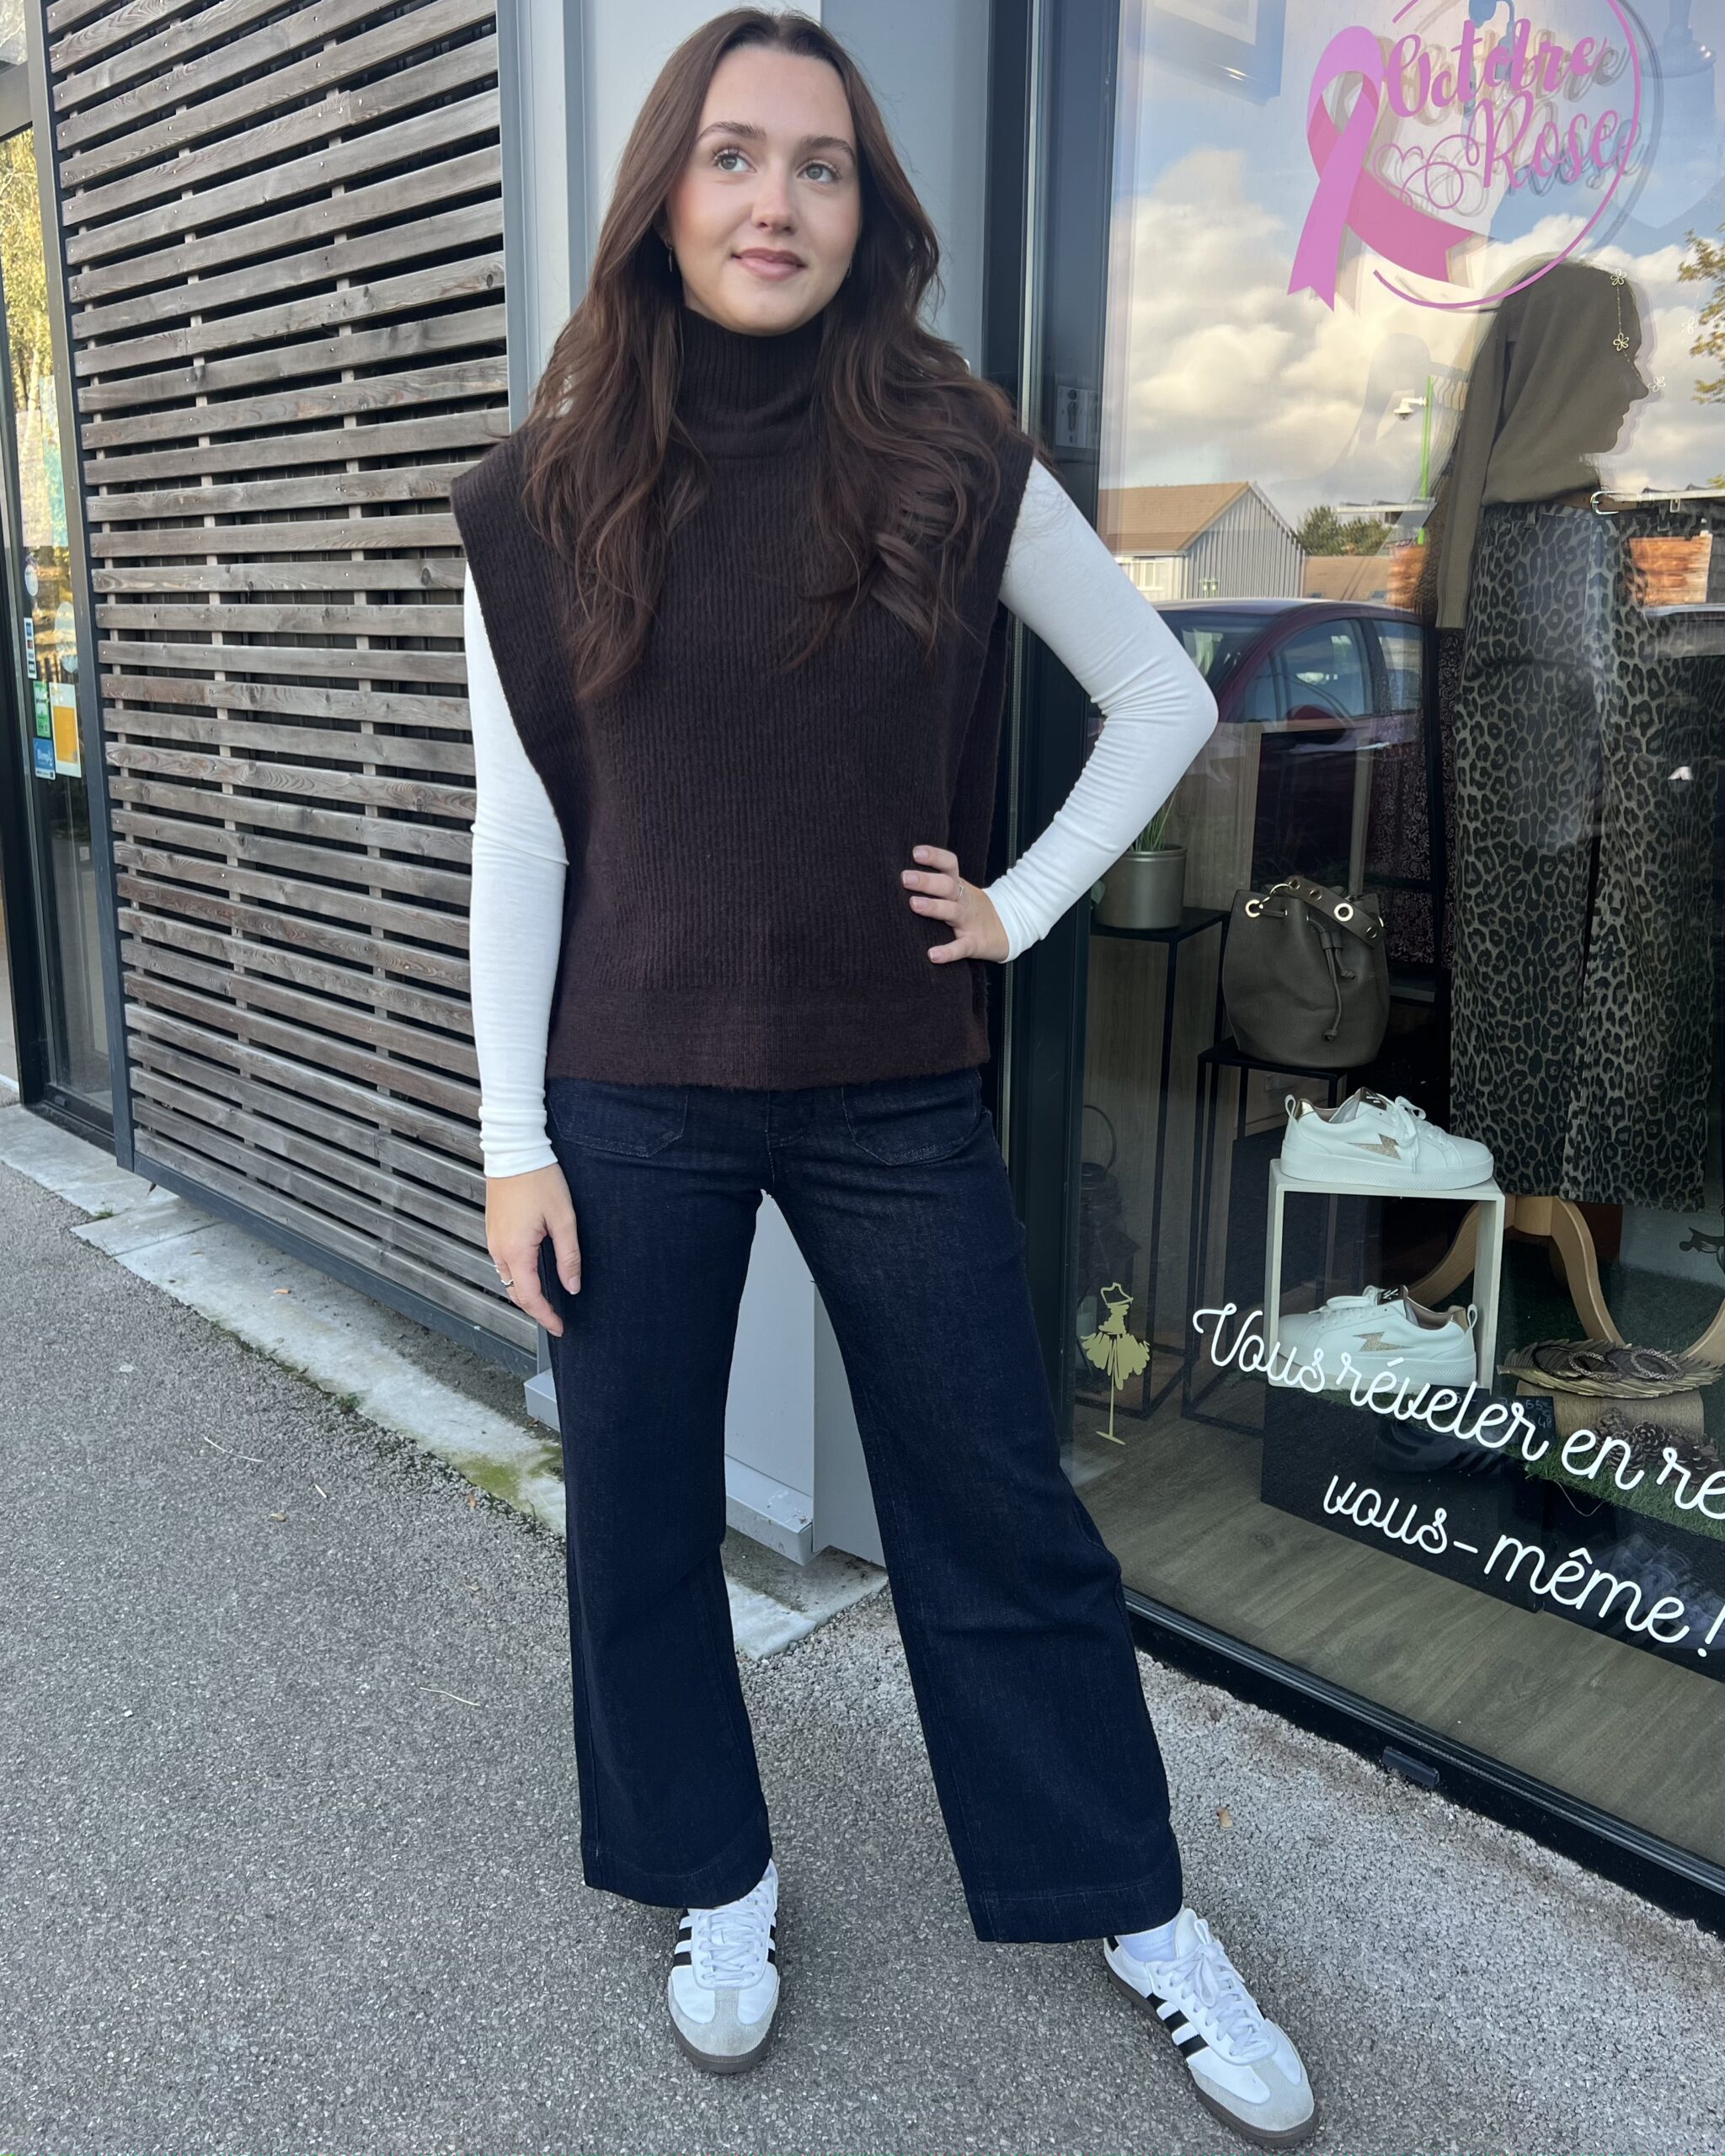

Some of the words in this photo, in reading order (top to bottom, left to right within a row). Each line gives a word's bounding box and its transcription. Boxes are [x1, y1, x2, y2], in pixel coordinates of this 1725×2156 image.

[1386, 18, 1608, 118] Octobre
[1465, 90, 1626, 189] Rose
[1193, 1303, 1326, 1393] Vous
[1562, 1429, 1645, 1490] en
